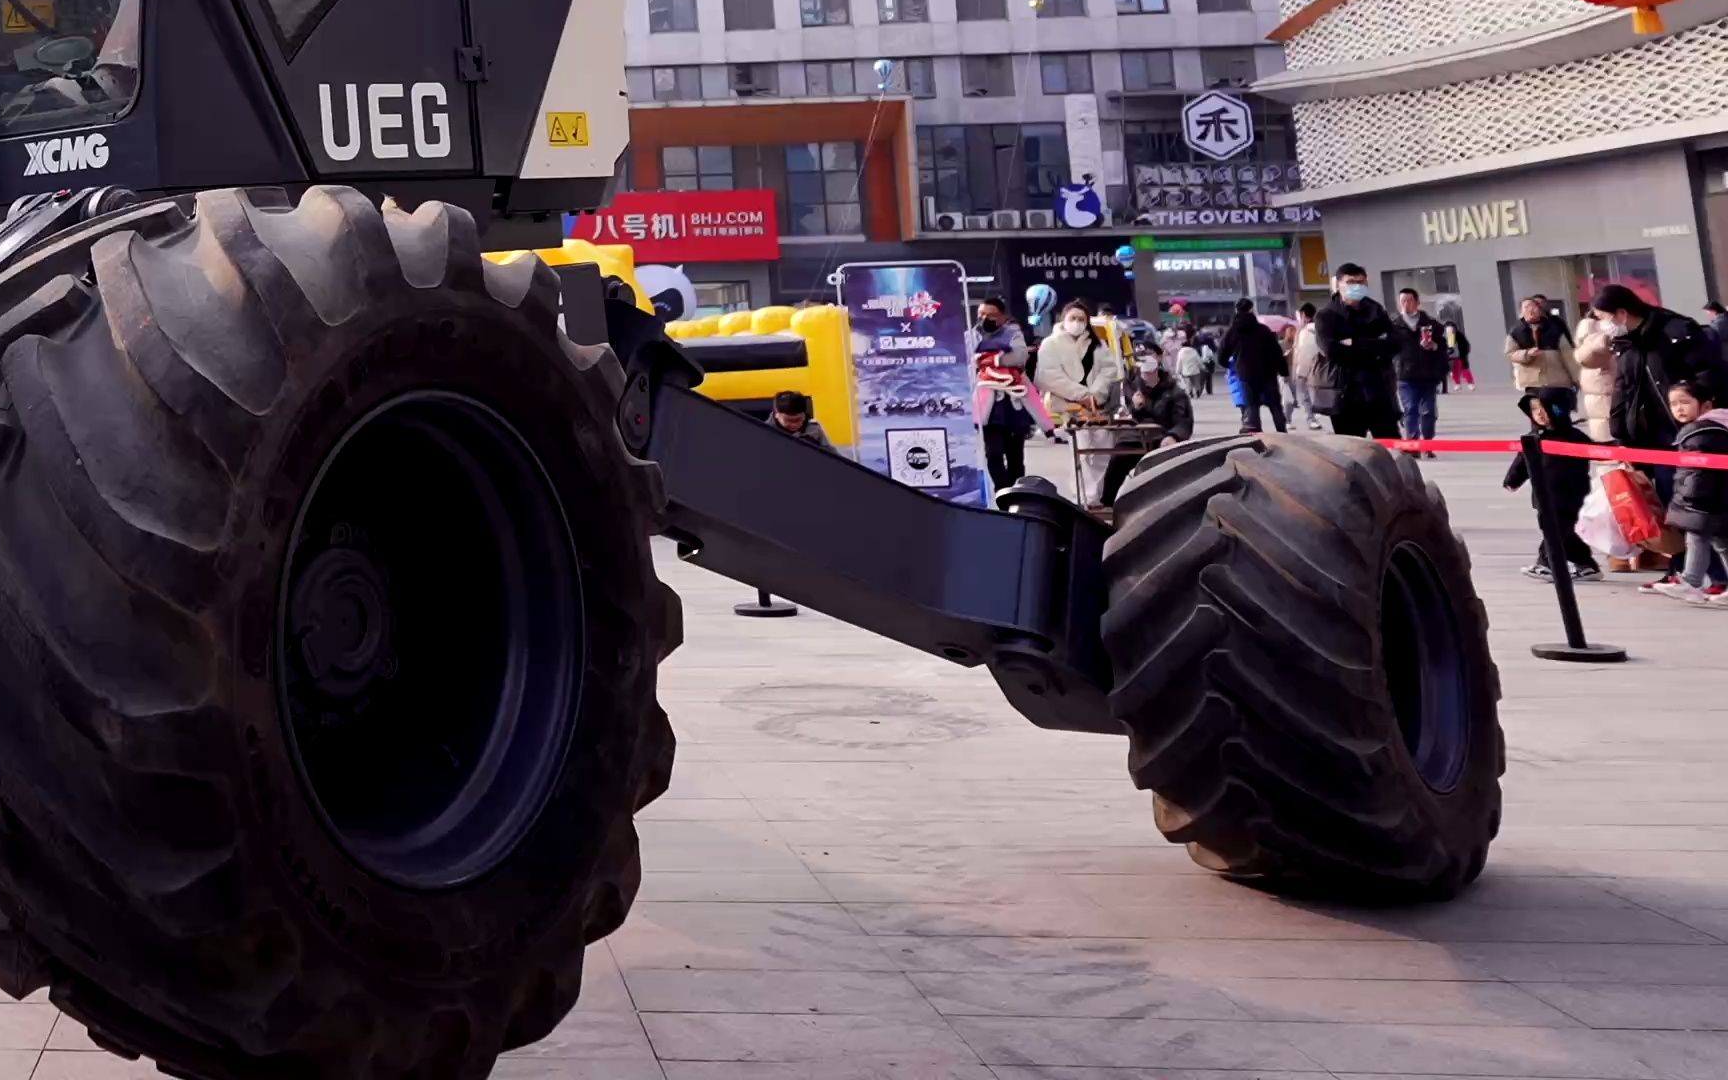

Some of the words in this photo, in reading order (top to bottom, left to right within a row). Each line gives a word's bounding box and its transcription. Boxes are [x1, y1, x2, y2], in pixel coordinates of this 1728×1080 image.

[318, 82, 451, 161] UEG
[1195, 107, 1241, 142] 禾
[23, 132, 109, 176] XCMG
[592, 213, 680, 241] 八号机
[690, 210, 764, 226] 8HJ.COM
[1156, 208, 1260, 225] THEOVEN
[1422, 199, 1529, 246] HUAWEI
[1021, 252, 1067, 268] luckin
